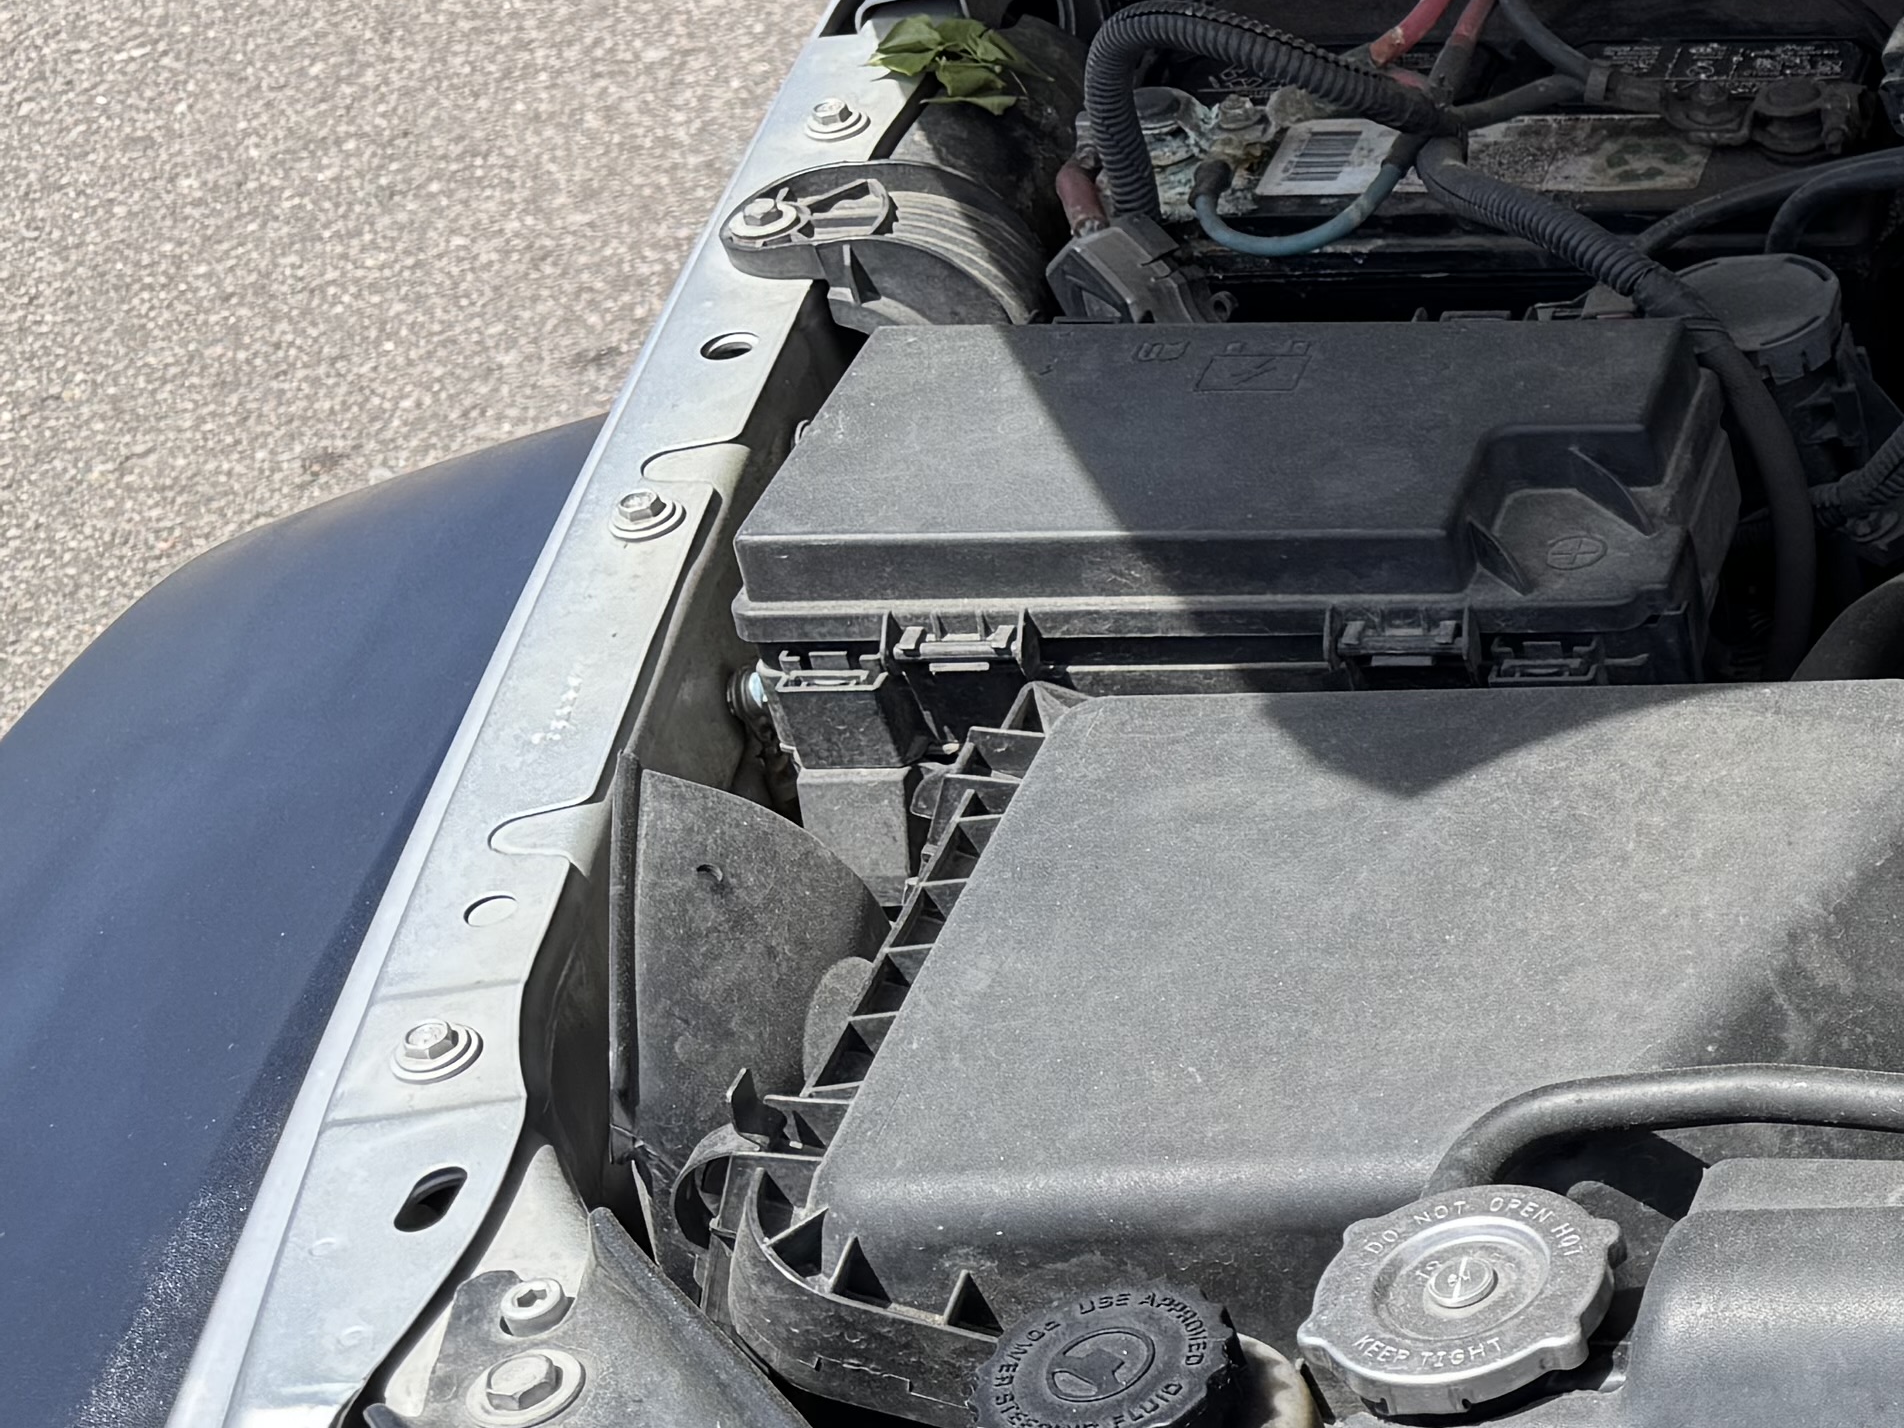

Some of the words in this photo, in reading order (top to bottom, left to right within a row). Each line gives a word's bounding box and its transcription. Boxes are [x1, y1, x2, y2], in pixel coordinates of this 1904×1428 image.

[1364, 1229, 1400, 1255] DO
[1413, 1199, 1467, 1225] NOT
[1489, 1196, 1556, 1223] OPEN
[1550, 1221, 1585, 1257] HOT
[993, 1319, 1062, 1388] POWER
[1079, 1292, 1132, 1315] USE
[1138, 1291, 1210, 1367] APPROVED
[1352, 1334, 1411, 1364] KEEP
[1420, 1336, 1503, 1368] TIGHT
